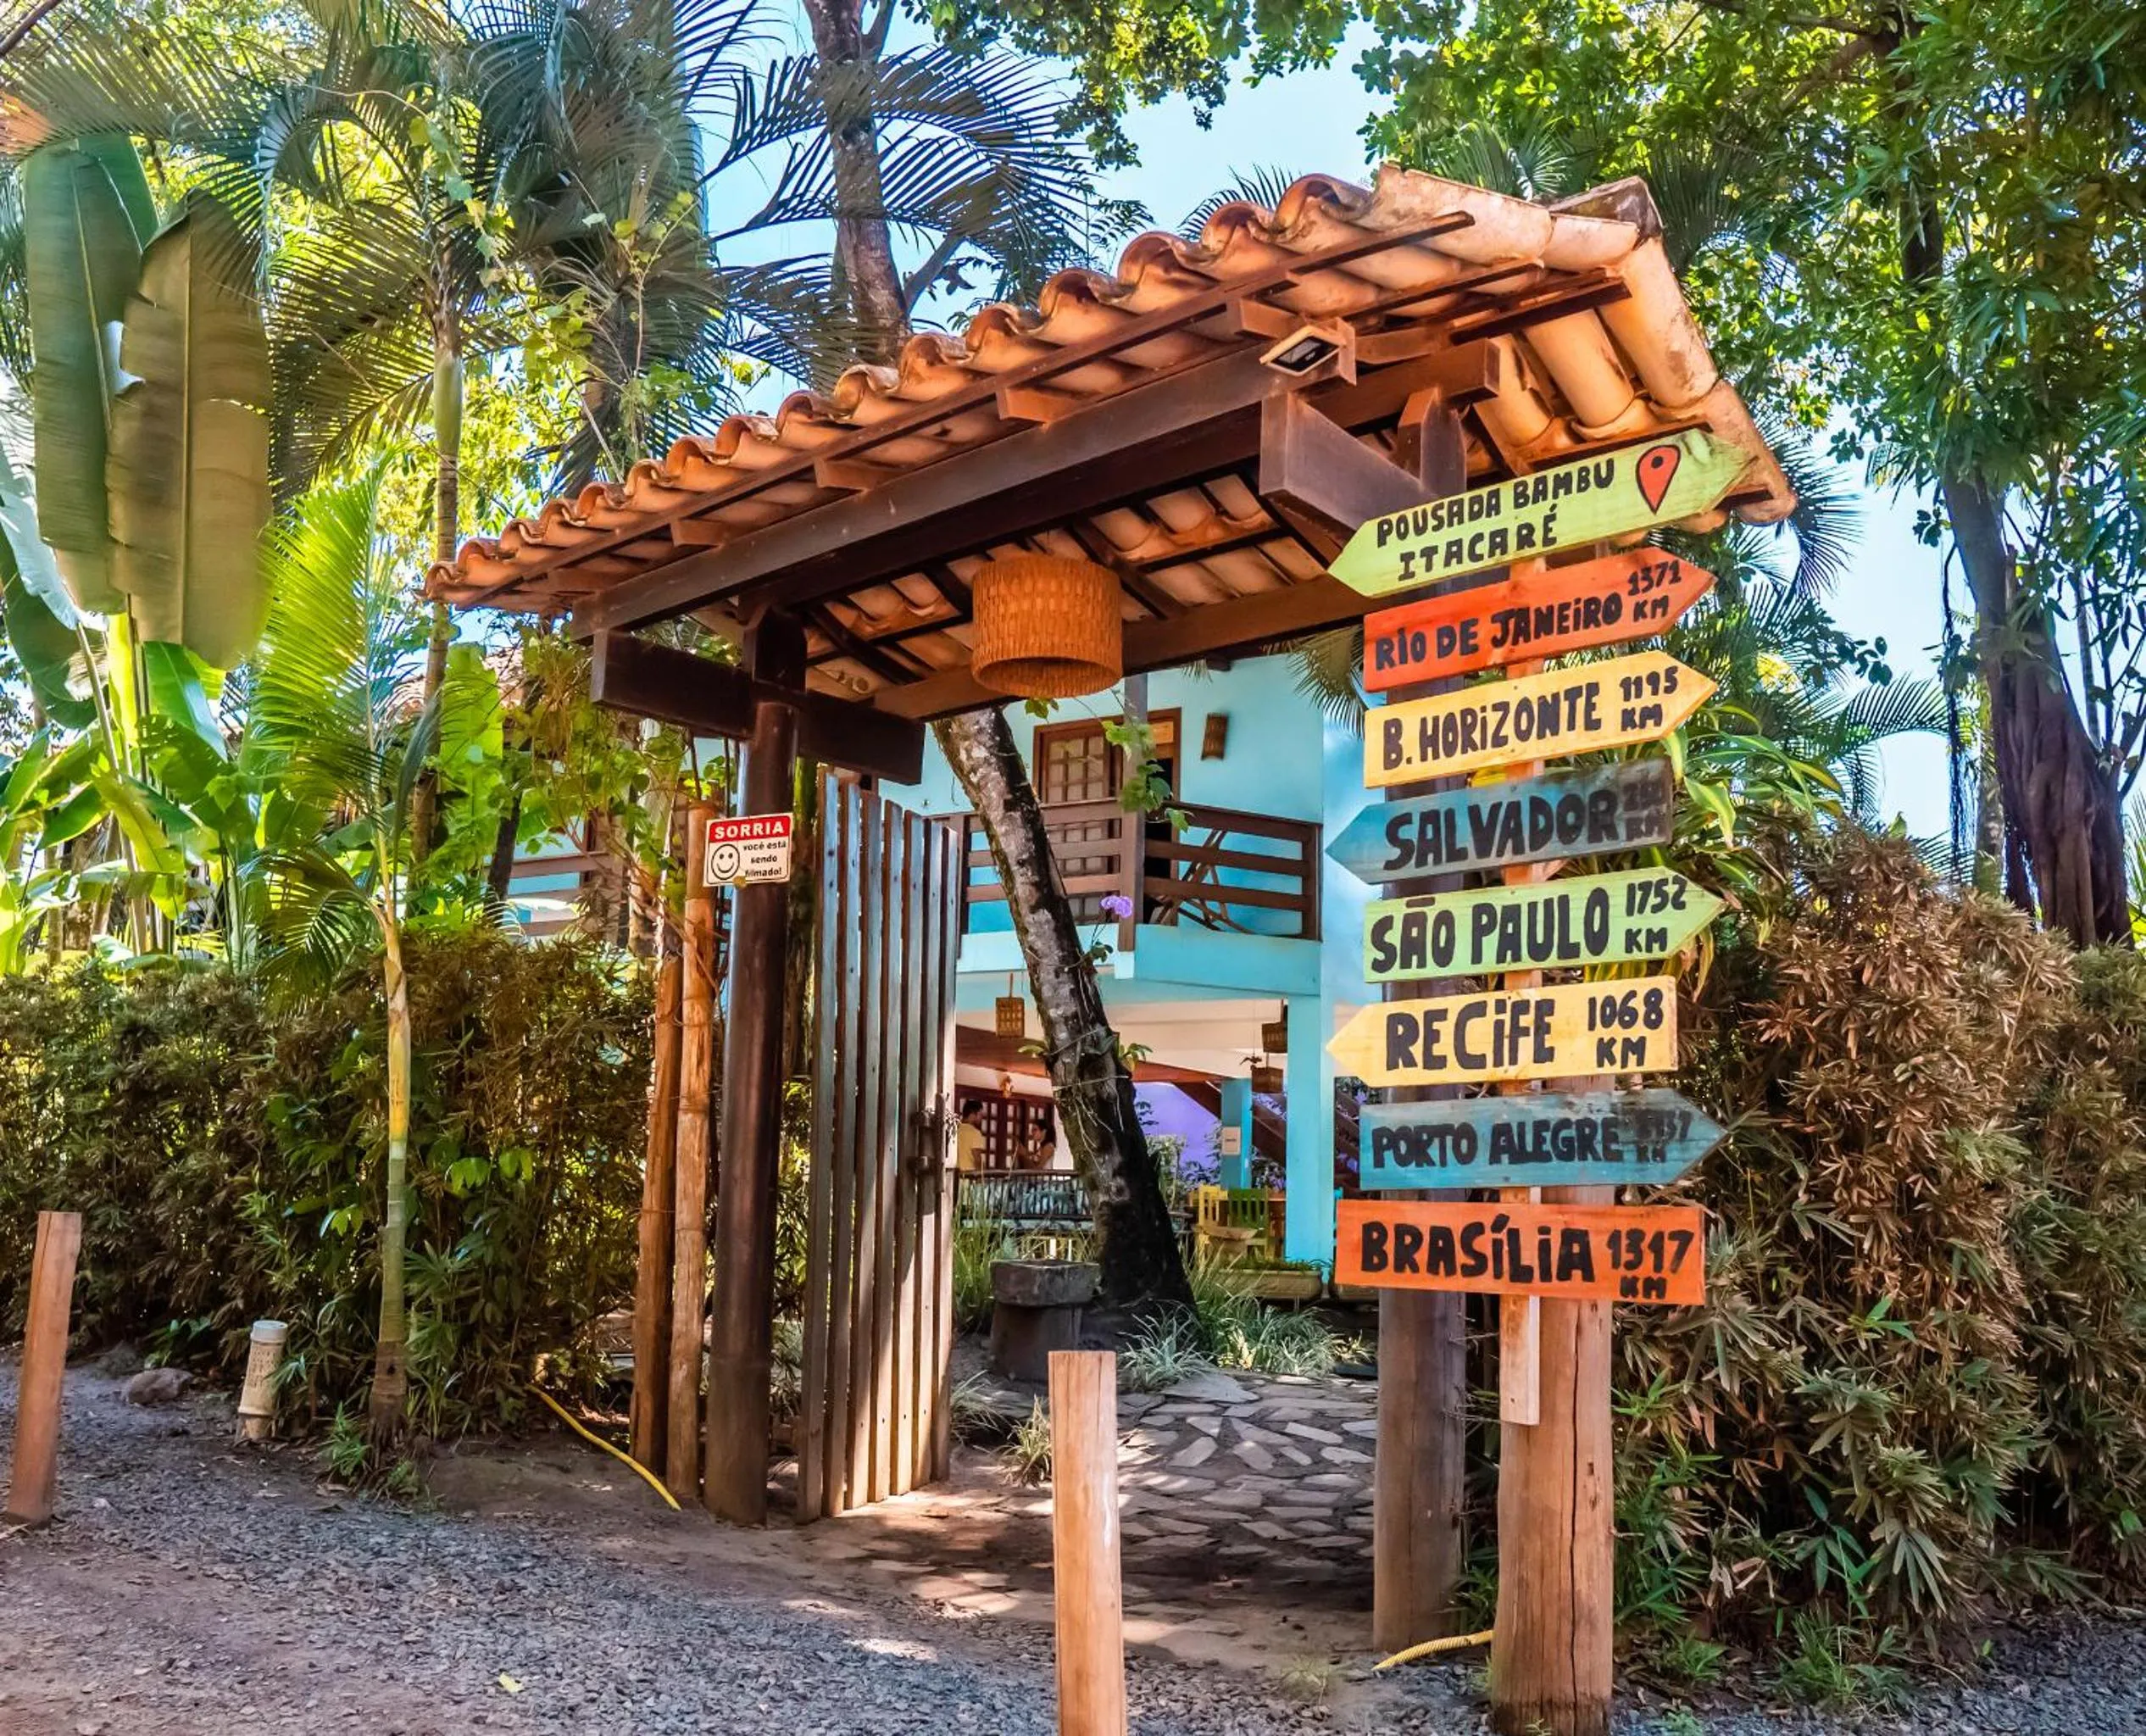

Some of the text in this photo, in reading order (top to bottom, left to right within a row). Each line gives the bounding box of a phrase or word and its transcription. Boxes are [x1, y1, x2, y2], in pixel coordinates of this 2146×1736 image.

[1376, 459, 1615, 548] POUSADA BAMBU
[1397, 504, 1558, 581] ITACARÉ
[1626, 559, 1683, 596] 1371
[1632, 595, 1670, 624] KM
[1437, 617, 1480, 659] DE
[1619, 665, 1679, 703] 1195
[1620, 704, 1664, 732] KM
[714, 821, 784, 840] SORRIA
[742, 840, 787, 851] você está
[1382, 789, 1621, 871] SALVADOR
[750, 854, 778, 864] sendo
[1625, 874, 1687, 918] 1752
[1370, 887, 1610, 974] SÃO PAULO
[1624, 926, 1667, 954] KM
[1587, 987, 1664, 1032] 1068
[1596, 1036, 1647, 1069] KM
[1371, 1117, 1625, 1170] PORTO ALEGRE
[1606, 1227, 1694, 1272] 1317
[1619, 1275, 1667, 1300] KM
